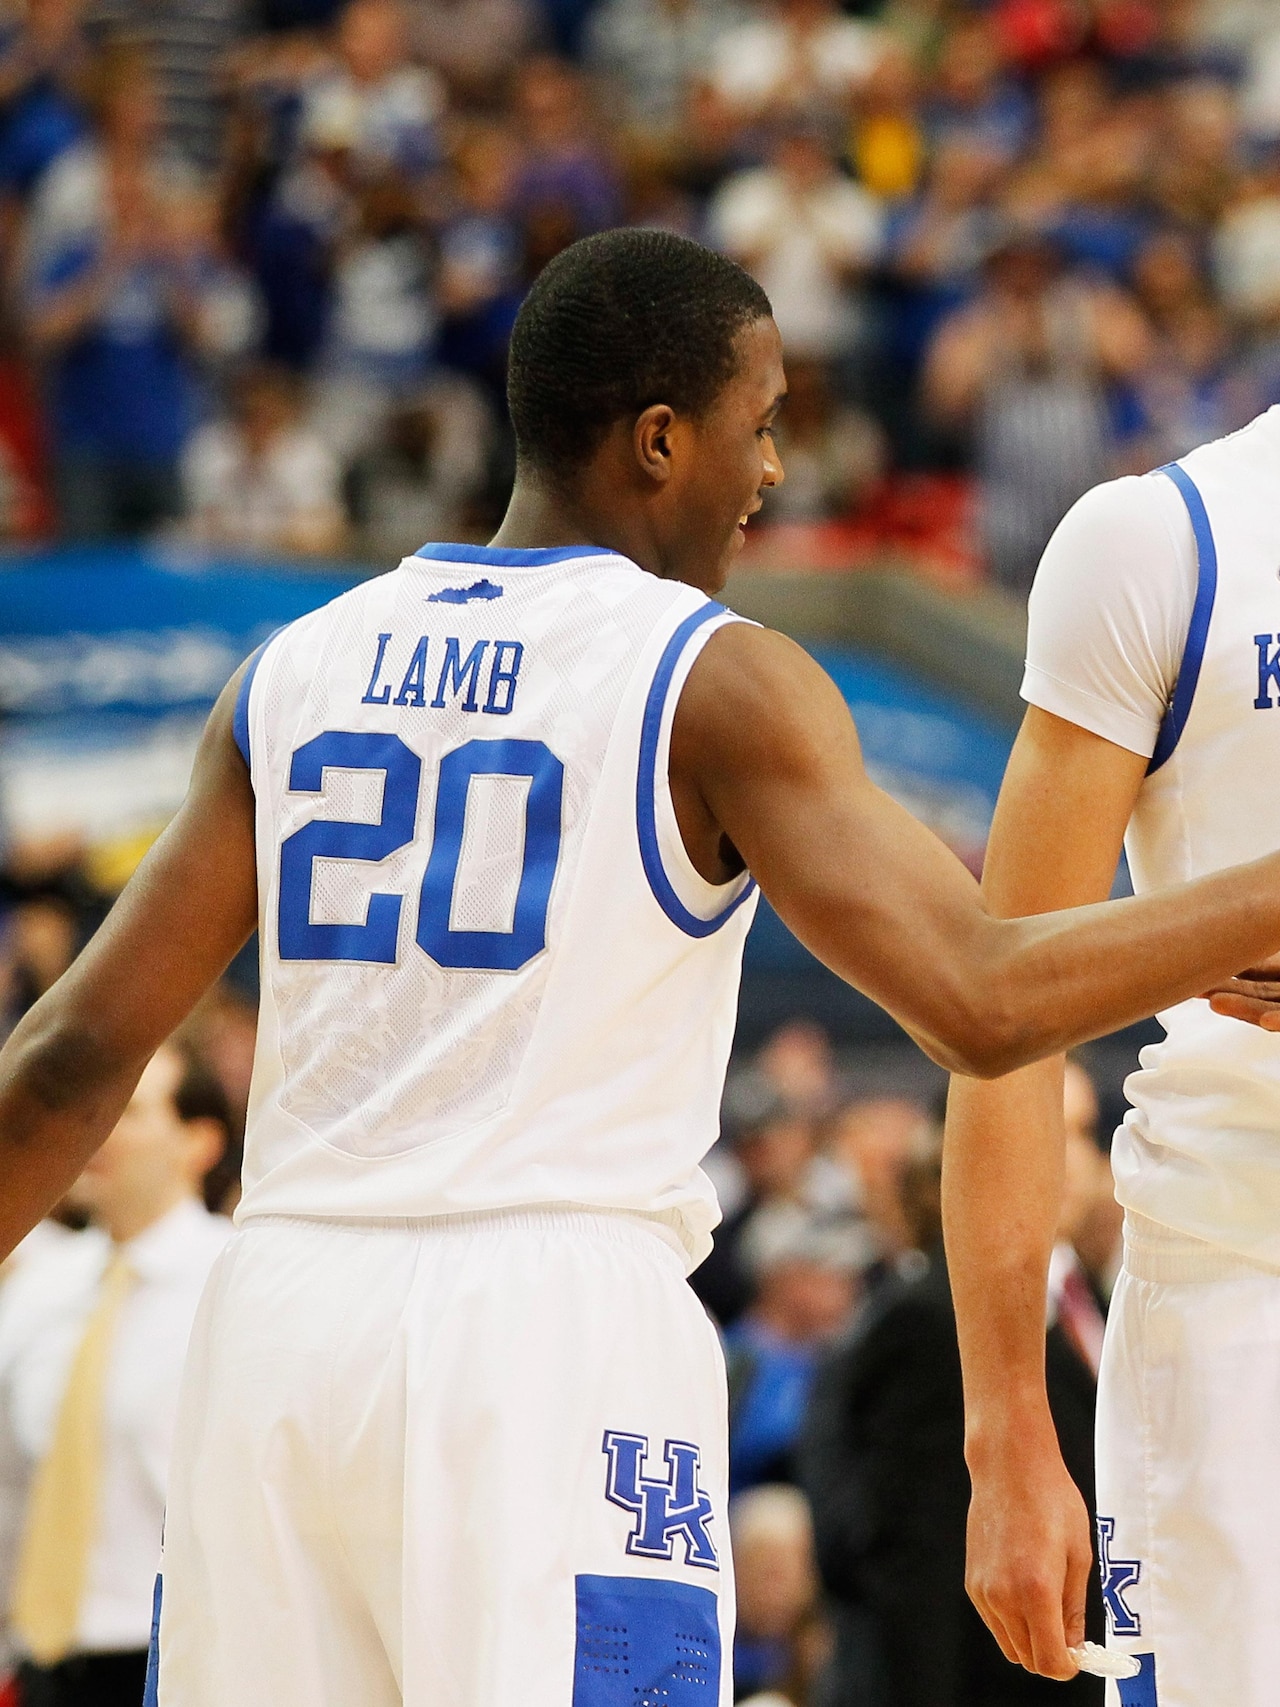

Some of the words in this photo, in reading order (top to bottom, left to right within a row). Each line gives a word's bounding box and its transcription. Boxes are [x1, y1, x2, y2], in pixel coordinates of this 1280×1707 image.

[361, 632, 525, 716] LAMB
[276, 730, 566, 972] 20
[601, 1429, 720, 1572] UK
